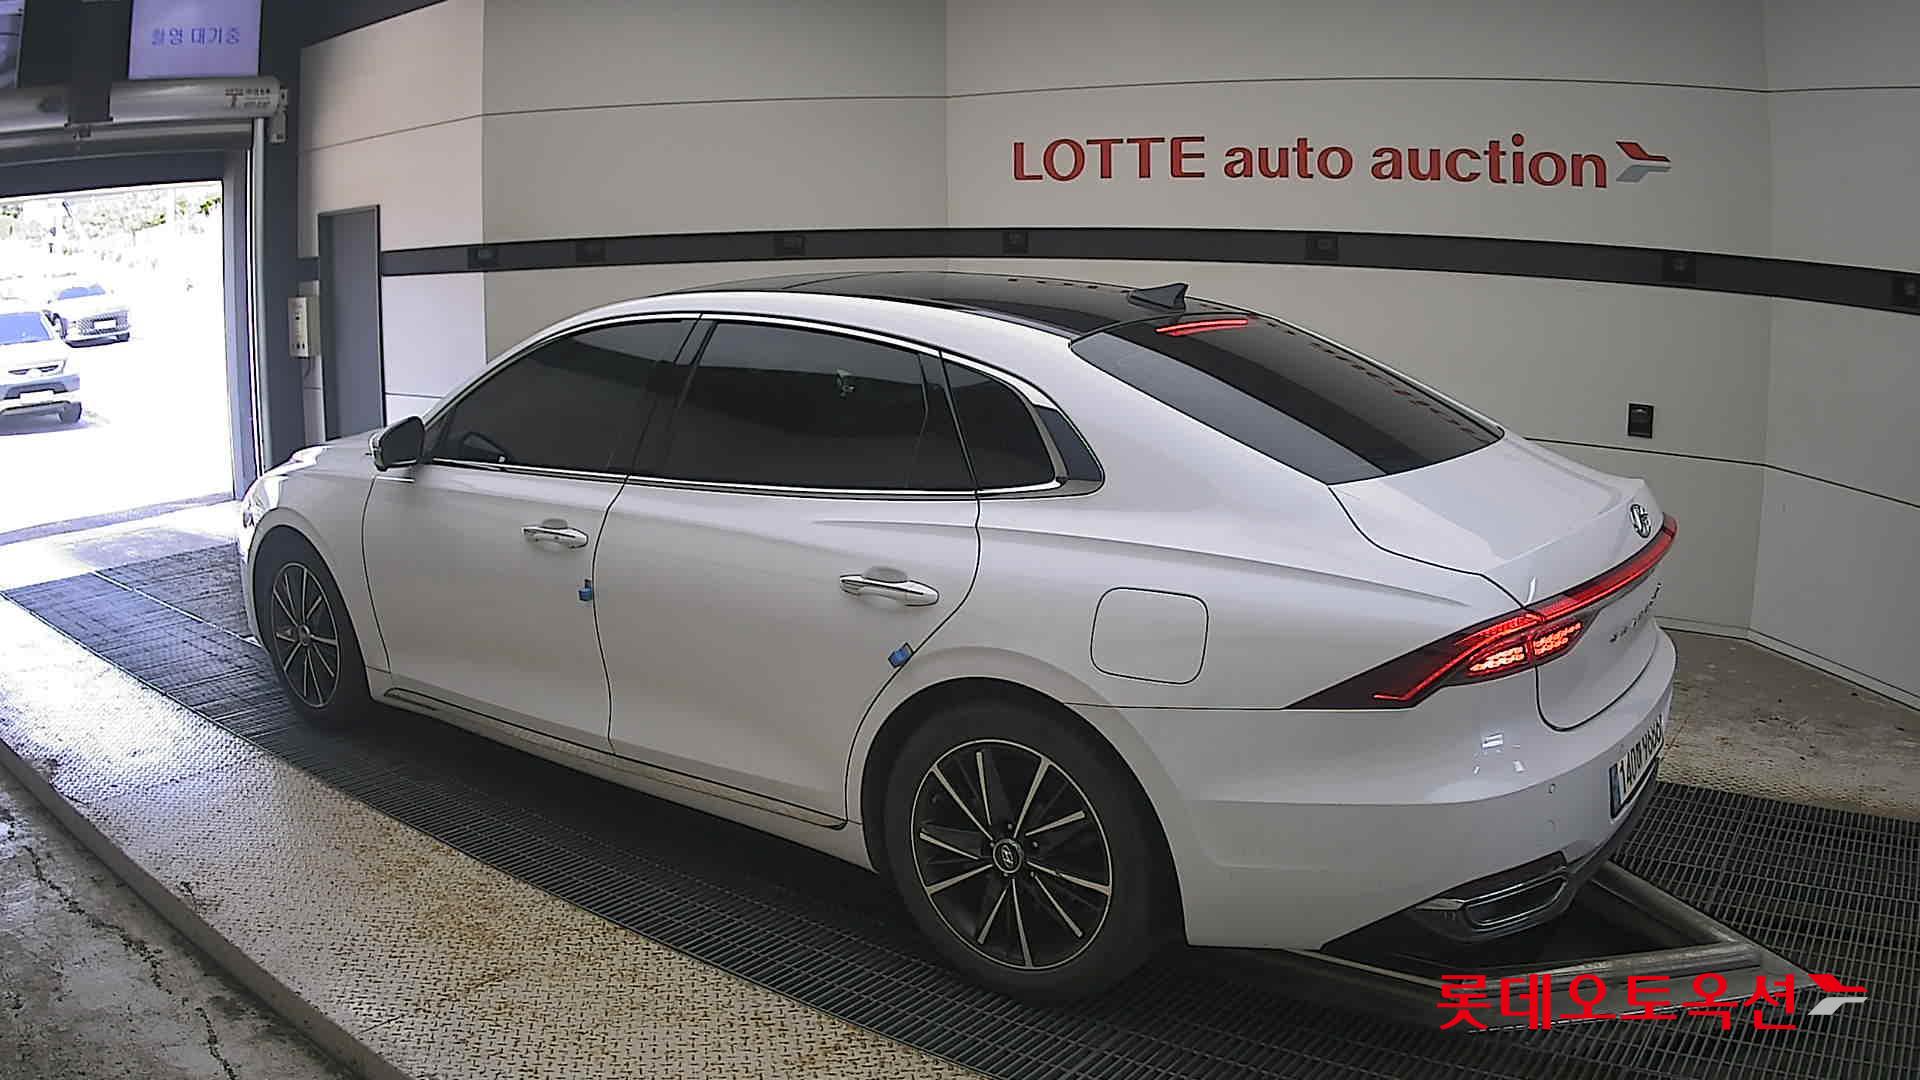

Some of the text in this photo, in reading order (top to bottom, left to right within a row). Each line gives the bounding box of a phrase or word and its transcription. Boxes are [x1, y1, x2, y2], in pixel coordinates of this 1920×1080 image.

[1013, 133, 1608, 189] LOTTE auto auction
